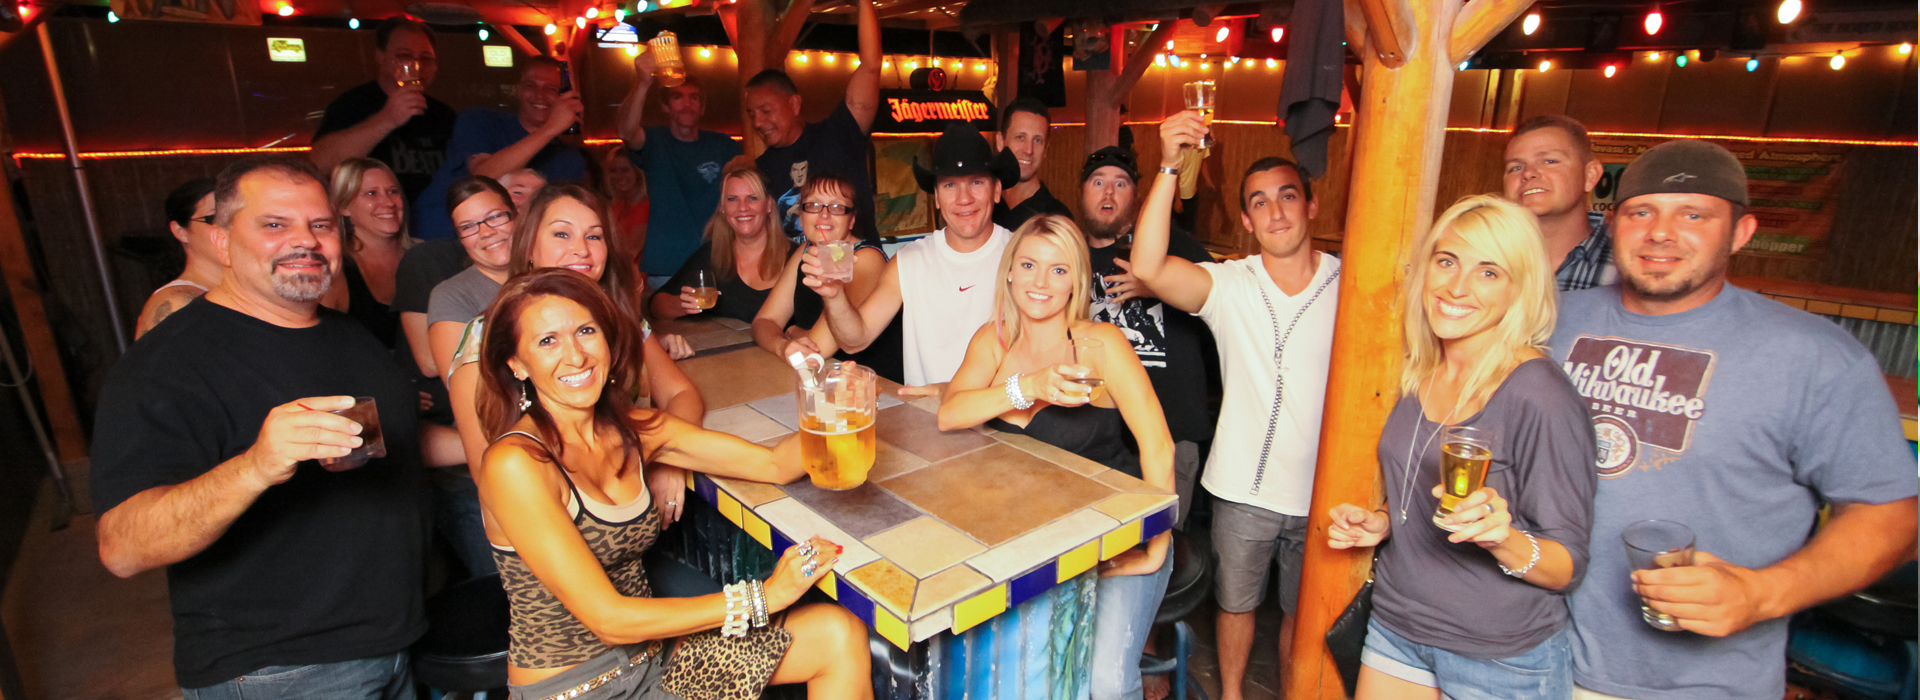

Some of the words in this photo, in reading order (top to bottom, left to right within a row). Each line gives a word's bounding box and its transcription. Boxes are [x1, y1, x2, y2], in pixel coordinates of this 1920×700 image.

[887, 98, 990, 123] Jägermeister
[1603, 345, 1662, 387] Old
[1563, 361, 1705, 420] Milwaukee
[1591, 402, 1638, 418] BEER
